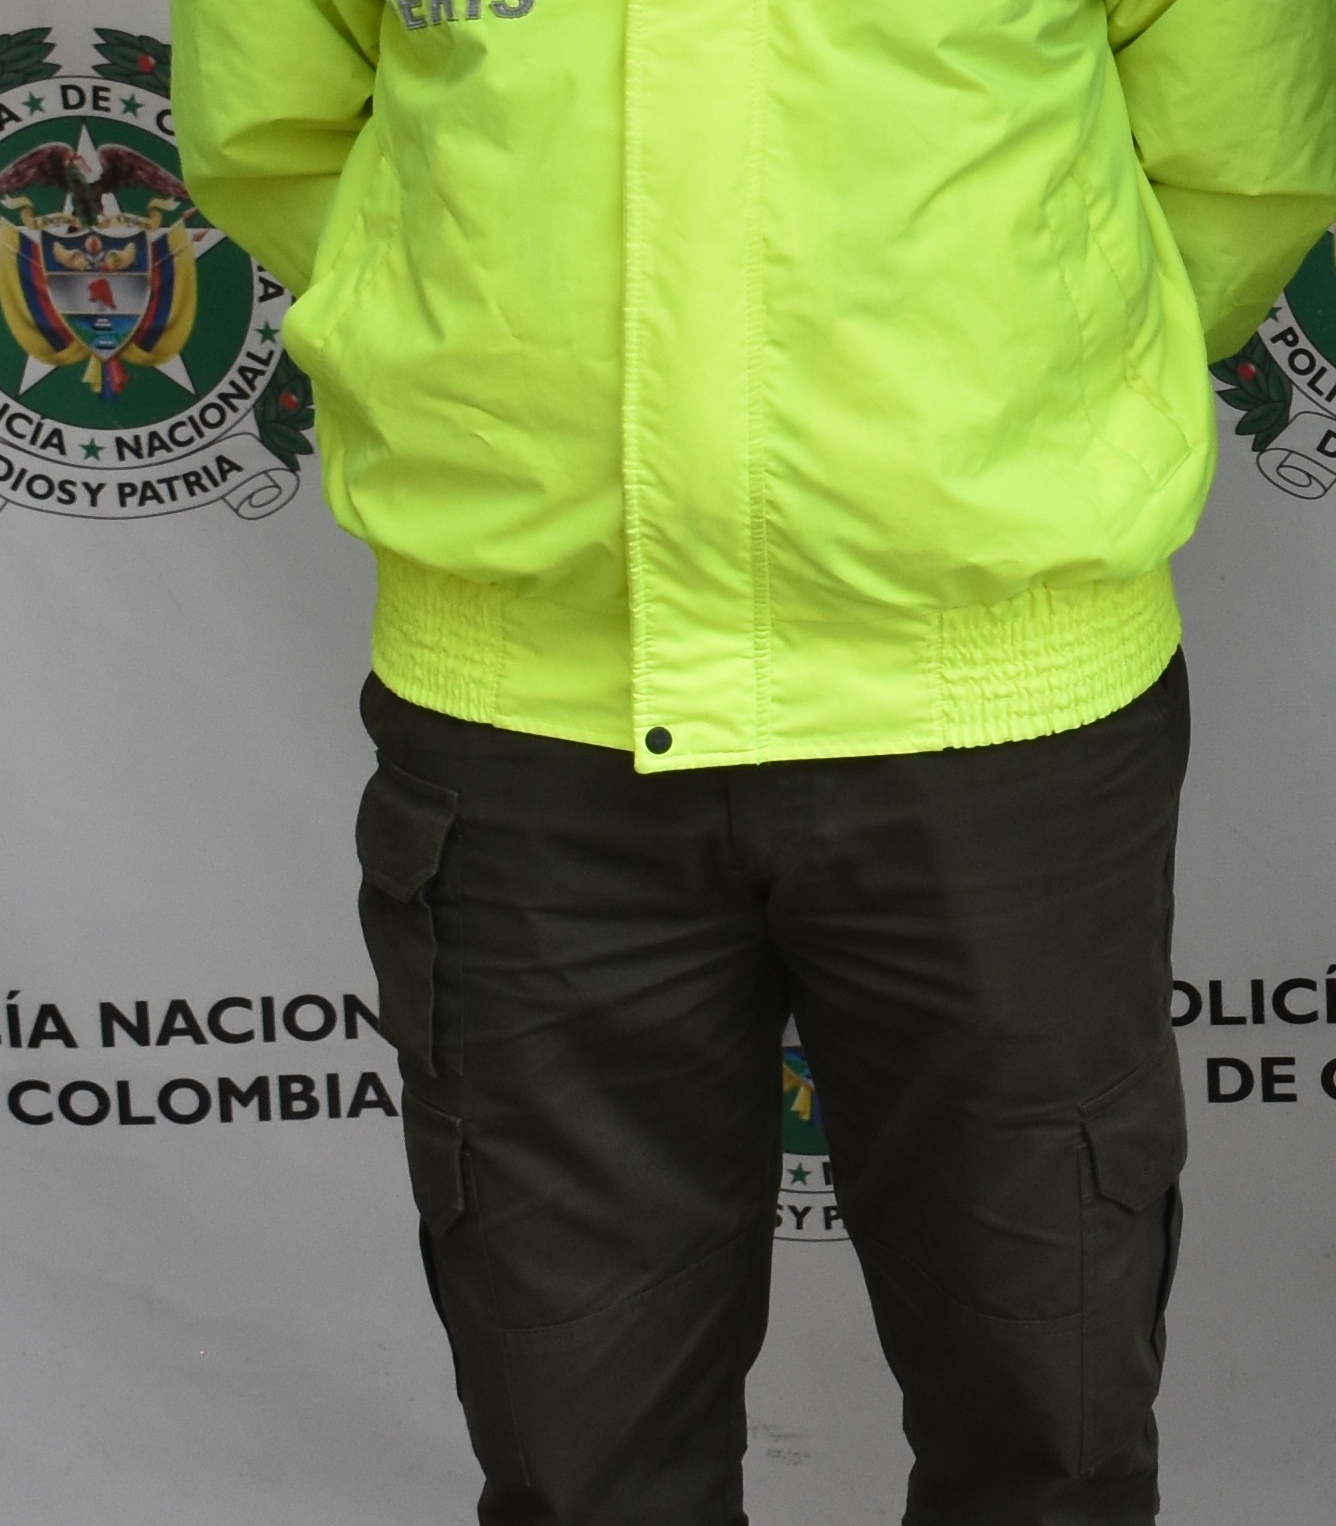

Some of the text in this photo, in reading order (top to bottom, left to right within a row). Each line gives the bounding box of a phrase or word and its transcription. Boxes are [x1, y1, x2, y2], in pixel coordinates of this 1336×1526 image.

[61, 84, 111, 112] DE
[115, 348, 274, 462] NACIONAL
[117, 454, 244, 508] PATRIA
[7, 1071, 400, 1126] COLOMBIA
[1207, 1056, 1297, 1103] DE
